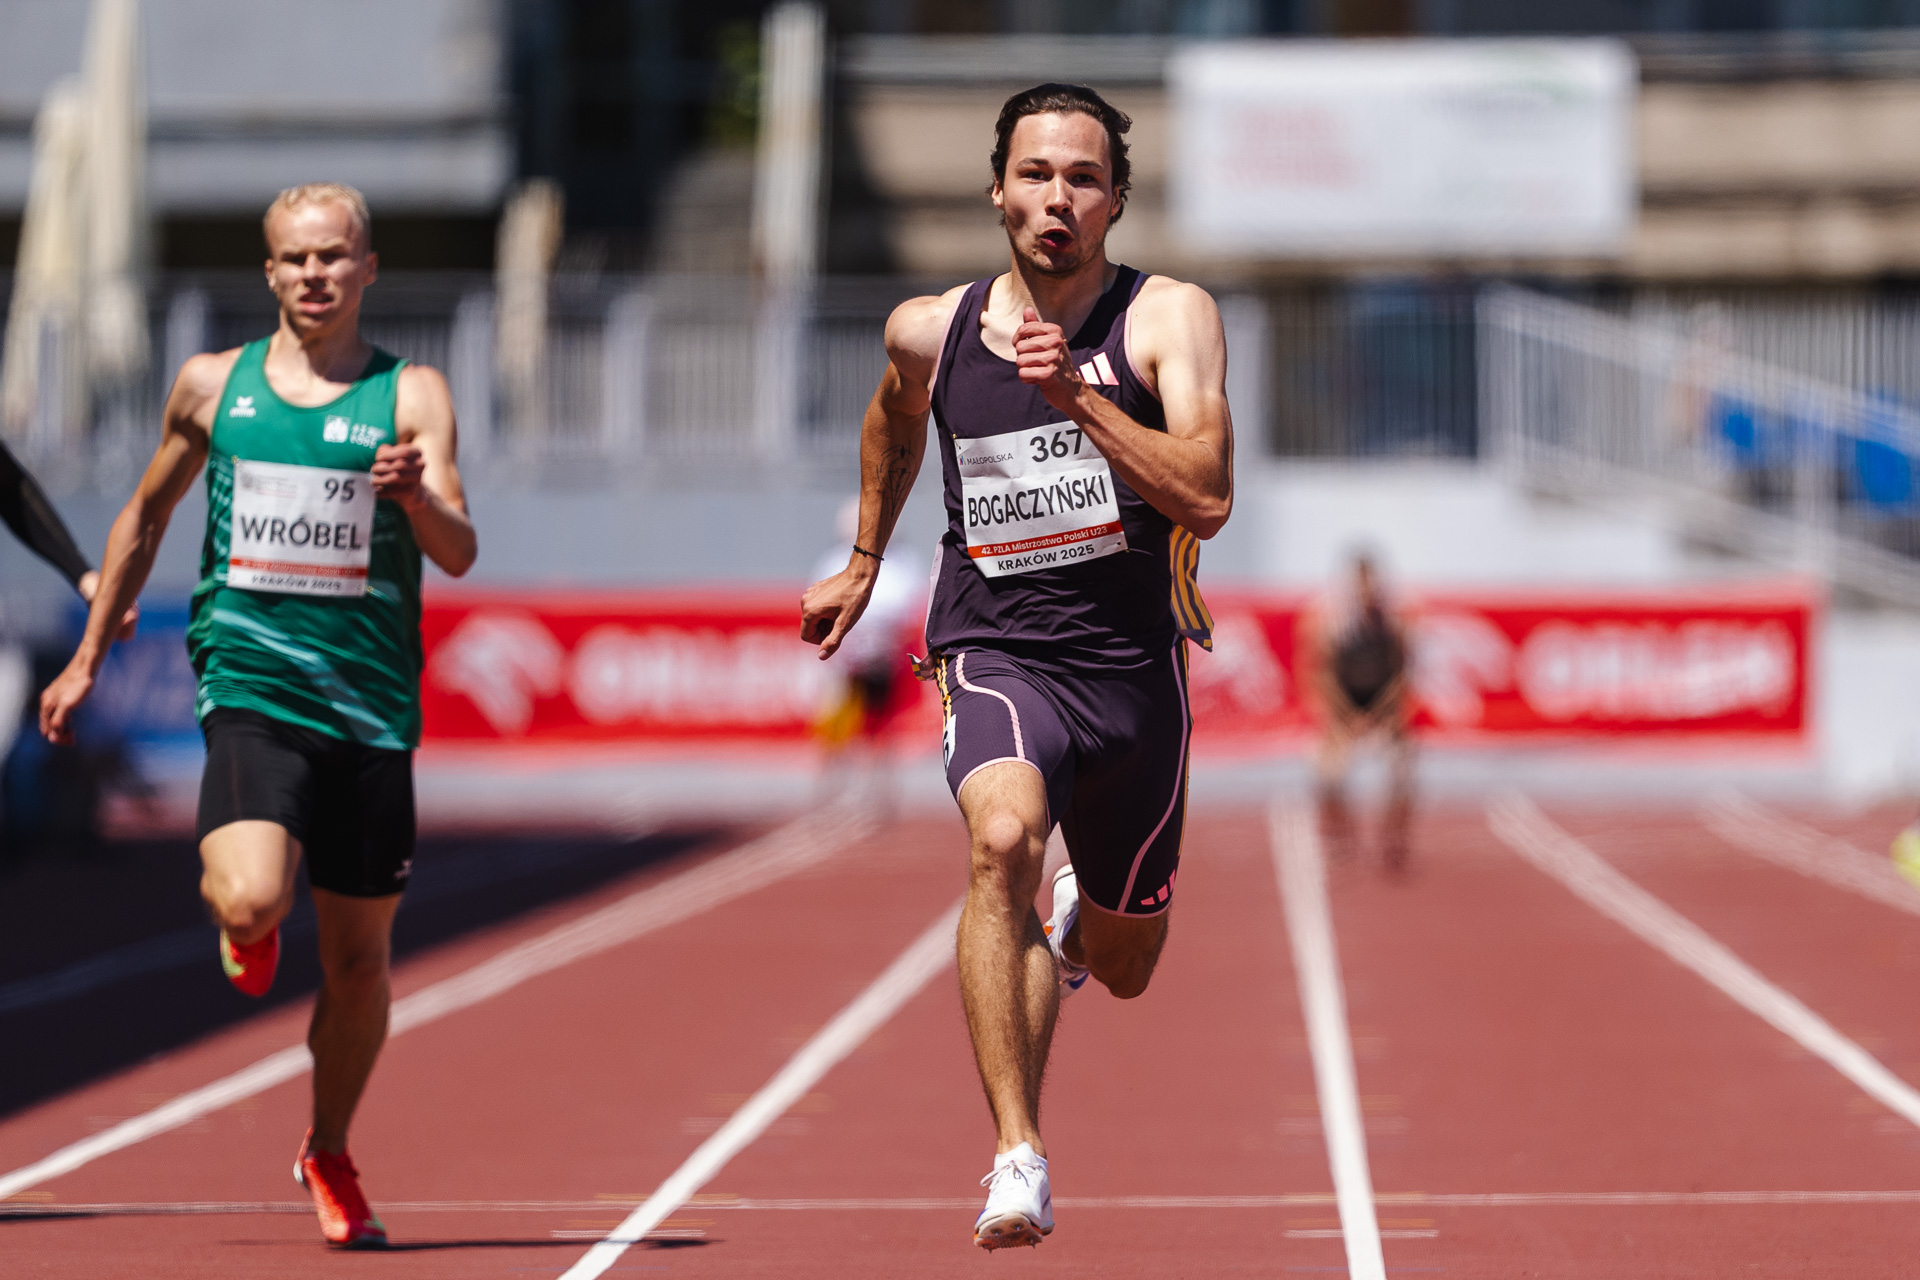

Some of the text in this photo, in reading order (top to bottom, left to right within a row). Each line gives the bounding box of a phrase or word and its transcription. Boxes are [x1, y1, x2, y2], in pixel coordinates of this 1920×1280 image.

[966, 452, 1014, 466] MAŁOPOLSKA
[1029, 428, 1083, 463] 367
[323, 477, 356, 503] 95
[967, 474, 1108, 527] BOGACZYŃSKI
[240, 513, 363, 550] WRÓBEL
[993, 543, 1011, 554] PZLA
[1012, 536, 1062, 551] Mistrzostwa
[1063, 529, 1089, 542] Polski
[1090, 525, 1108, 536] U23
[997, 544, 1095, 571] KRAKÓW 2025
